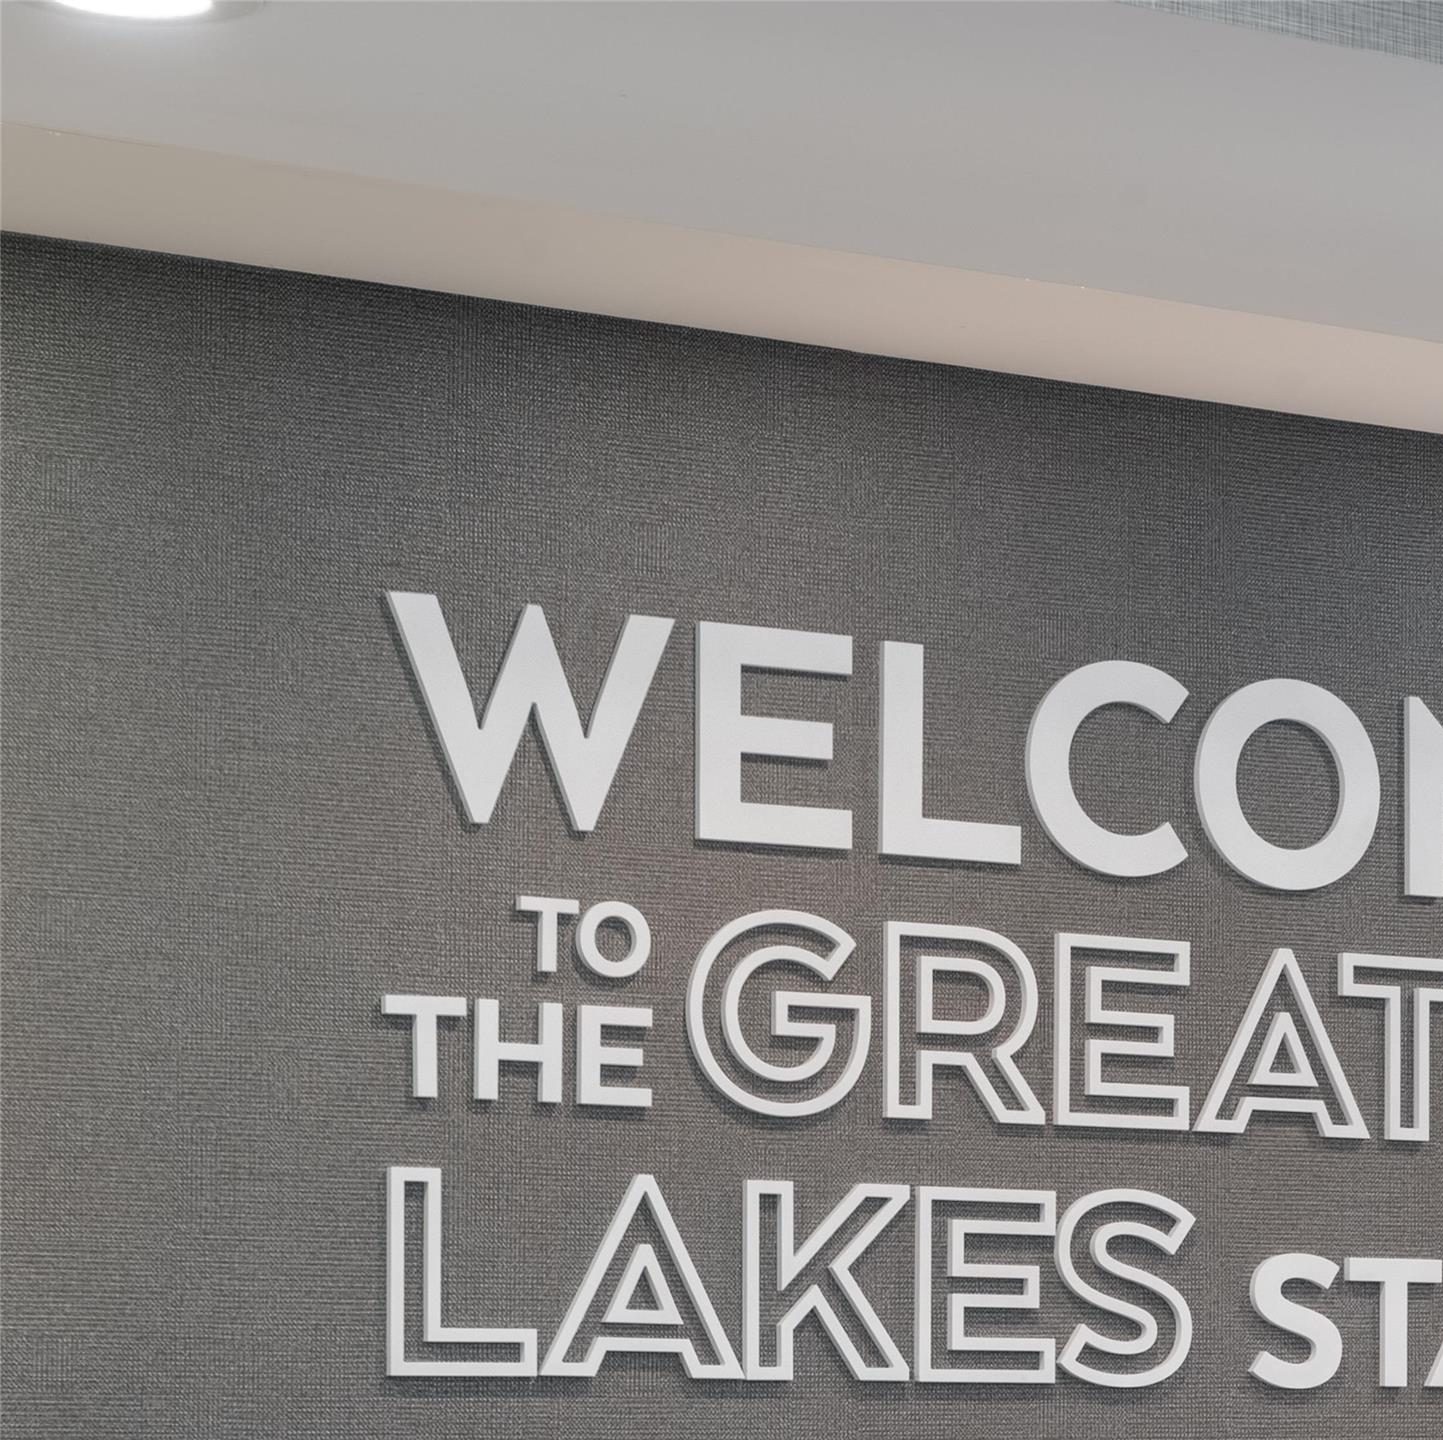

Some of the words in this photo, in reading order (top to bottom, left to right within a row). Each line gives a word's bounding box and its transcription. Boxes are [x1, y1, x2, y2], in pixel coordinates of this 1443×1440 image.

[516, 894, 652, 979] TO
[382, 994, 654, 1109] THE
[386, 1165, 1197, 1389] LAKES
